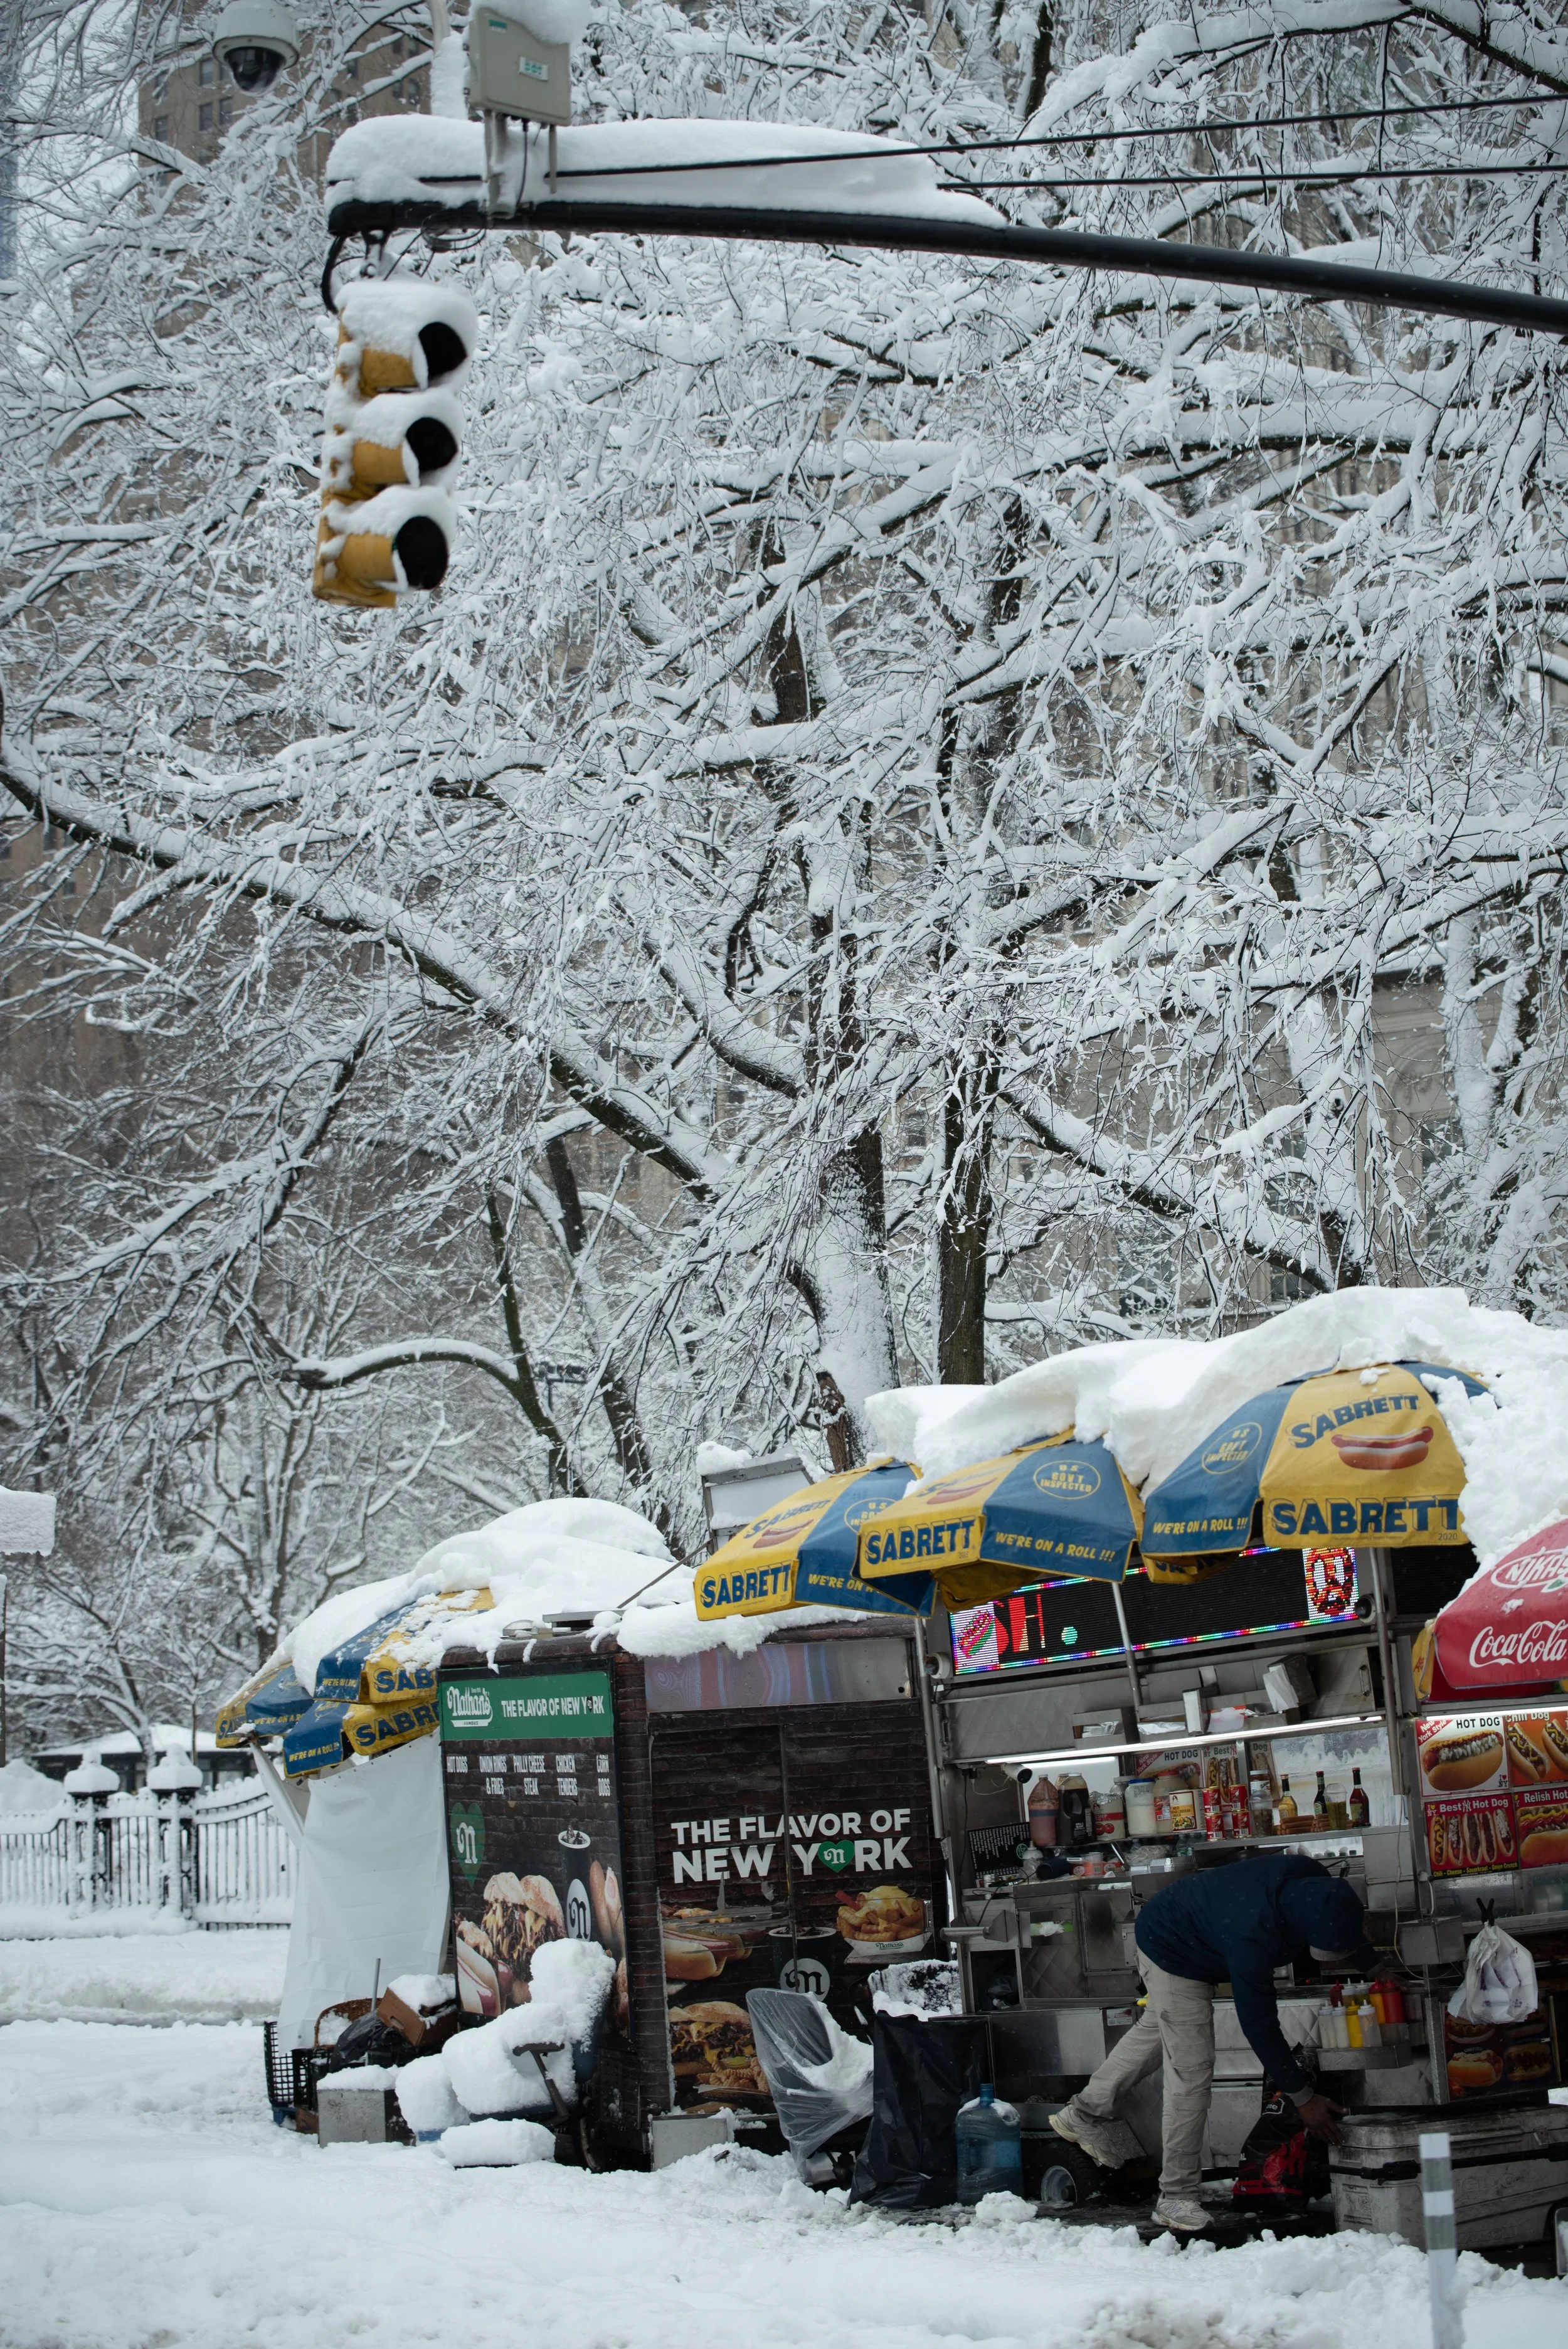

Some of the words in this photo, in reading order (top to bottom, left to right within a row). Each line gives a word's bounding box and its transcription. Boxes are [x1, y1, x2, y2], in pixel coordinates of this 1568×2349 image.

[1286, 1393, 1419, 1448] SABRETT
[1205, 1450, 1249, 1463] INSPECTED
[1040, 1478, 1093, 1493] INSPECTED
[743, 1500, 831, 1539] SABRETT
[1269, 1494, 1459, 1535] SABRETT
[1153, 1521, 1186, 1534] WE'RE
[1187, 1520, 1200, 1532] ON
[1201, 1520, 1208, 1531] A
[1210, 1518, 1234, 1531] ROLL
[1236, 1517, 1248, 1530] !!!
[865, 1515, 976, 1565] SABRETT
[1438, 1533, 1458, 1541] 2020
[995, 1532, 1033, 1548] WE'RE
[1035, 1539, 1054, 1551] ON
[1055, 1542, 1064, 1554] A
[1067, 1544, 1096, 1559] ROLL
[1099, 1549, 1116, 1562] !!!
[700, 1559, 792, 1608] SABRETT
[808, 1573, 844, 1588] WE'RE
[847, 1579, 862, 1591] ON
[447, 1686, 492, 1717] Nathan's
[501, 1700, 517, 1717] THE
[518, 1698, 548, 1717] FLAVOR
[549, 1698, 559, 1716] OF
[560, 1697, 580, 1715] NEW
[254, 1715, 275, 1725] WE'RE
[278, 1715, 287, 1723] ON
[1420, 1720, 1435, 1732] New
[1456, 1719, 1476, 1729] HOT
[1480, 1717, 1500, 1727] DOG
[1418, 1730, 1433, 1742] York
[1432, 1719, 1447, 1733] Style
[289, 1750, 307, 1762] WE'RE
[308, 1749, 316, 1758] ON
[317, 1747, 322, 1756] A
[1164, 1752, 1179, 1761] HOT
[1182, 1749, 1198, 1759] DOG
[1214, 1746, 1229, 1755] Best
[1253, 1743, 1268, 1752] Dog
[446, 1756, 455, 1773] HOT
[456, 1756, 469, 1773] DOGS
[479, 1756, 493, 1773] ONION
[493, 1756, 507, 1773] RINGS
[513, 1755, 528, 1773] PHILLY
[528, 1755, 546, 1773] CHEESE
[556, 1755, 576, 1773] CHICKEN
[596, 1754, 610, 1773] CORN
[485, 1778, 491, 1795] &
[491, 1778, 504, 1795] FRIES
[524, 1778, 539, 1795] STEAK
[557, 1778, 578, 1796] TENDERS
[598, 1778, 611, 1796] DOGS
[1439, 1803, 1461, 1813] Best
[1473, 1800, 1489, 1809] Hot
[1491, 1798, 1508, 1808] Dog
[1524, 1791, 1550, 1803] Relish
[1552, 1790, 1568, 1800] Hot
[670, 1818, 731, 1845] THE
[739, 1812, 862, 1840] FLAVOR
[870, 1808, 911, 1833] OF
[672, 1843, 776, 1884] NEW
